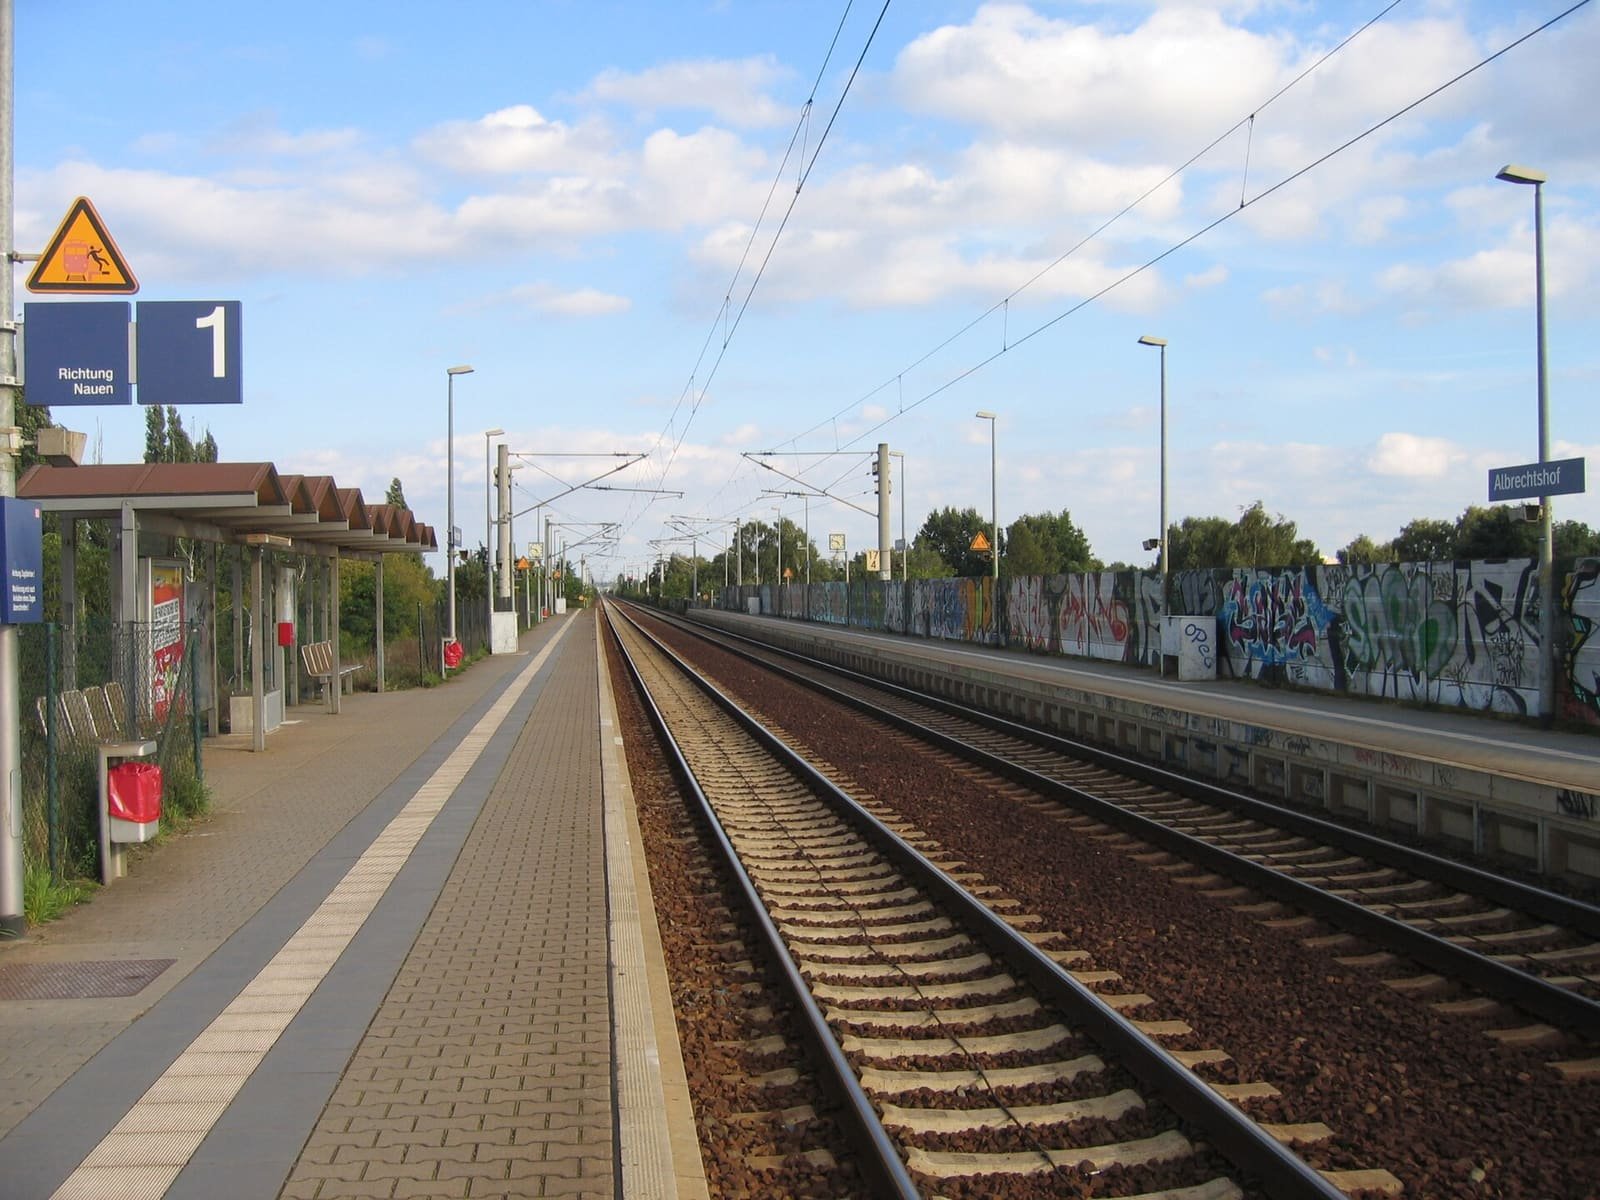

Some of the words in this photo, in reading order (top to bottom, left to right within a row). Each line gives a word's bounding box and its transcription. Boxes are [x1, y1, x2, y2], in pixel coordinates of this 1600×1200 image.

[196, 306, 226, 378] 1
[58, 367, 114, 382] Richtung
[73, 383, 114, 395] Nauen
[1493, 466, 1561, 491] Albrechtshof
